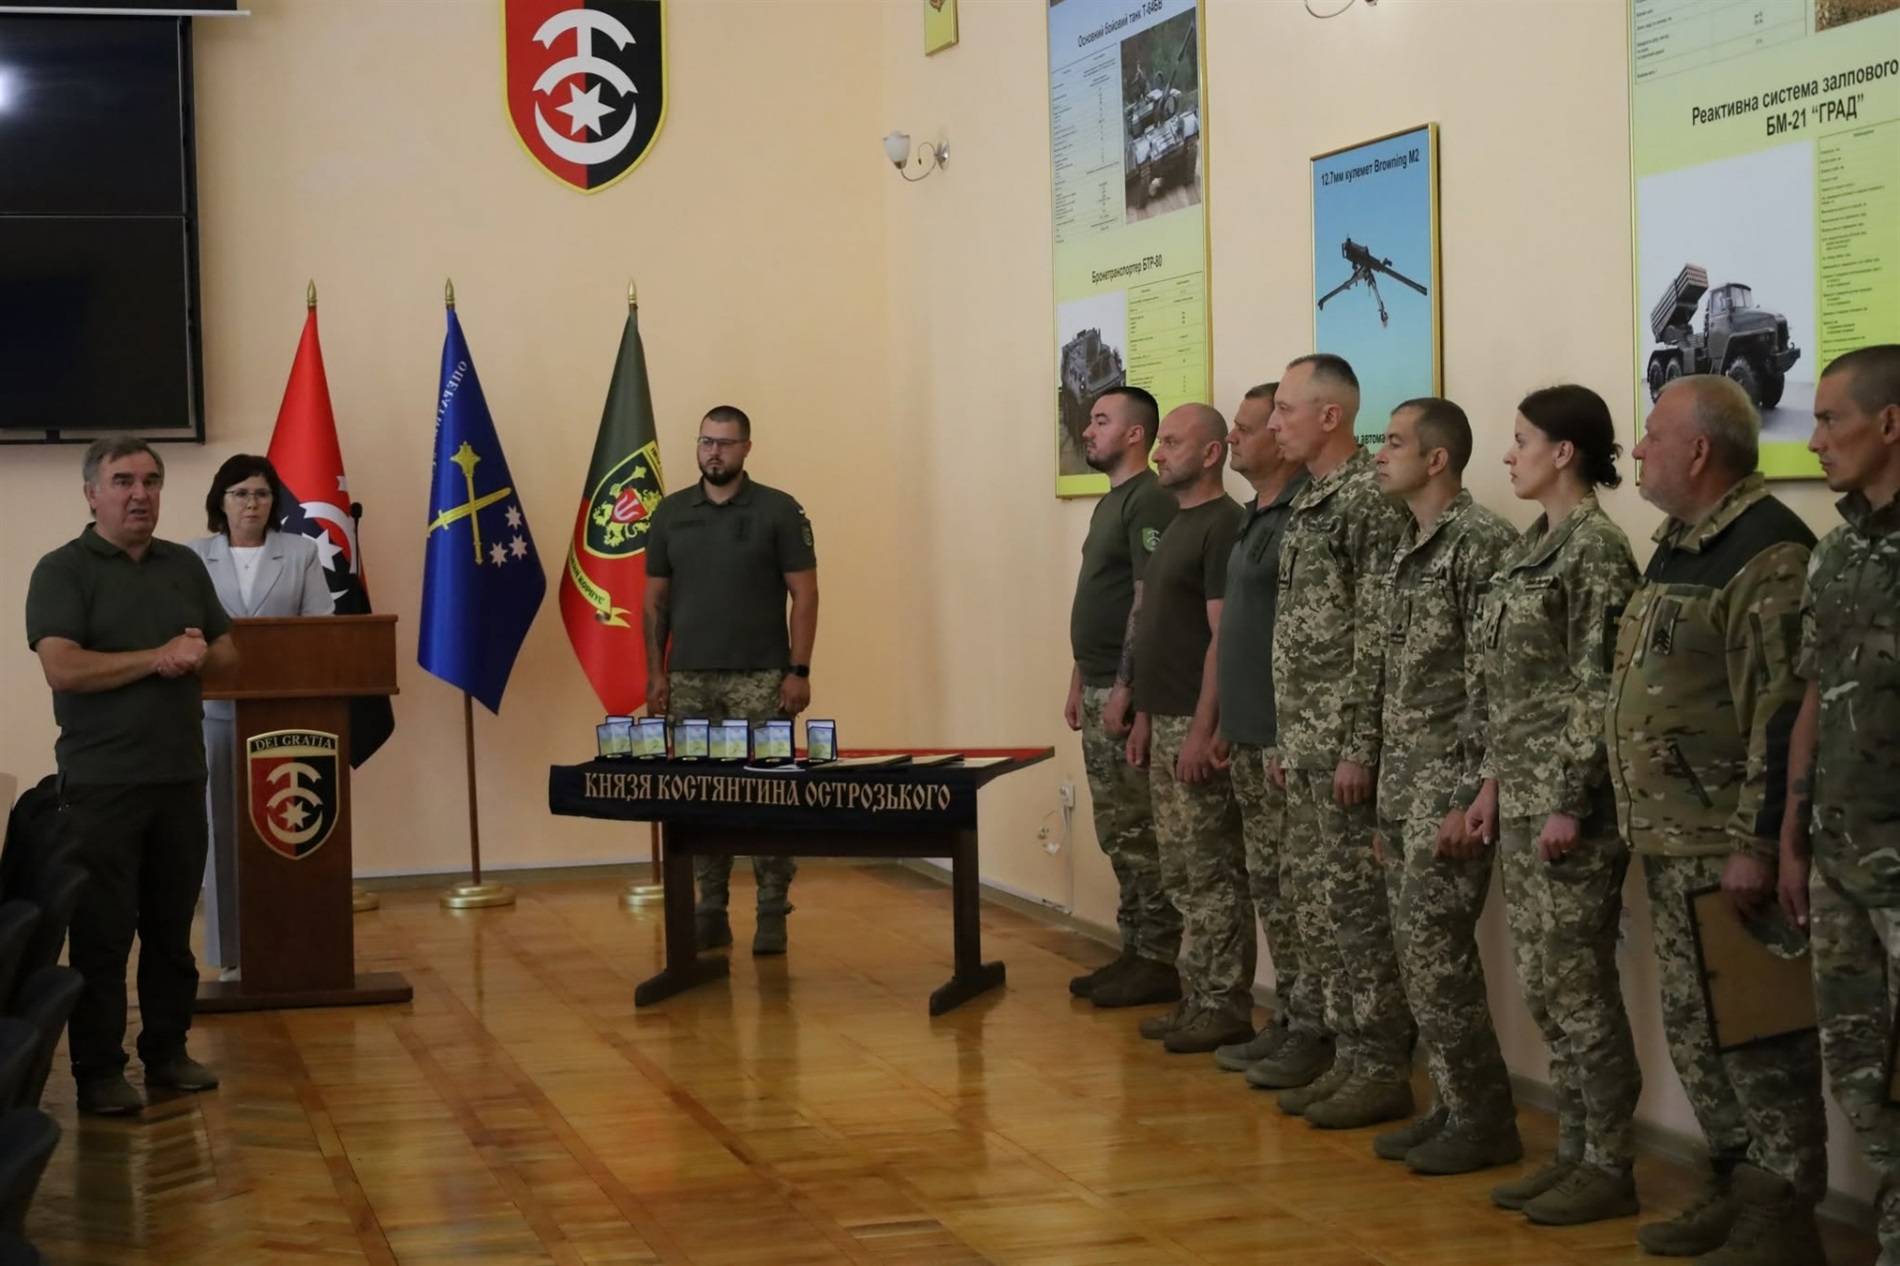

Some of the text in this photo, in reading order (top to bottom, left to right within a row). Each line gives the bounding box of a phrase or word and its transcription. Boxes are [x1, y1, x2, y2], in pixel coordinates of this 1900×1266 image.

[1078, 25, 1104, 47] Основний
[1105, 13, 1128, 35] бойовий
[1129, 9, 1141, 23] танк
[1692, 58, 1899, 126] Реактивна система залпового
[1766, 108, 1807, 136] БМ-21
[1345, 163, 1373, 183] кулемет
[1374, 153, 1407, 173] Browning
[1408, 148, 1420, 164] M2
[1142, 254, 1163, 271] БТР-80
[255, 735, 332, 751] DEI GRATIA
[584, 772, 950, 812] КНЯЗЯ КОСТЯНТИНА ОСТРОЗЬКОГО
